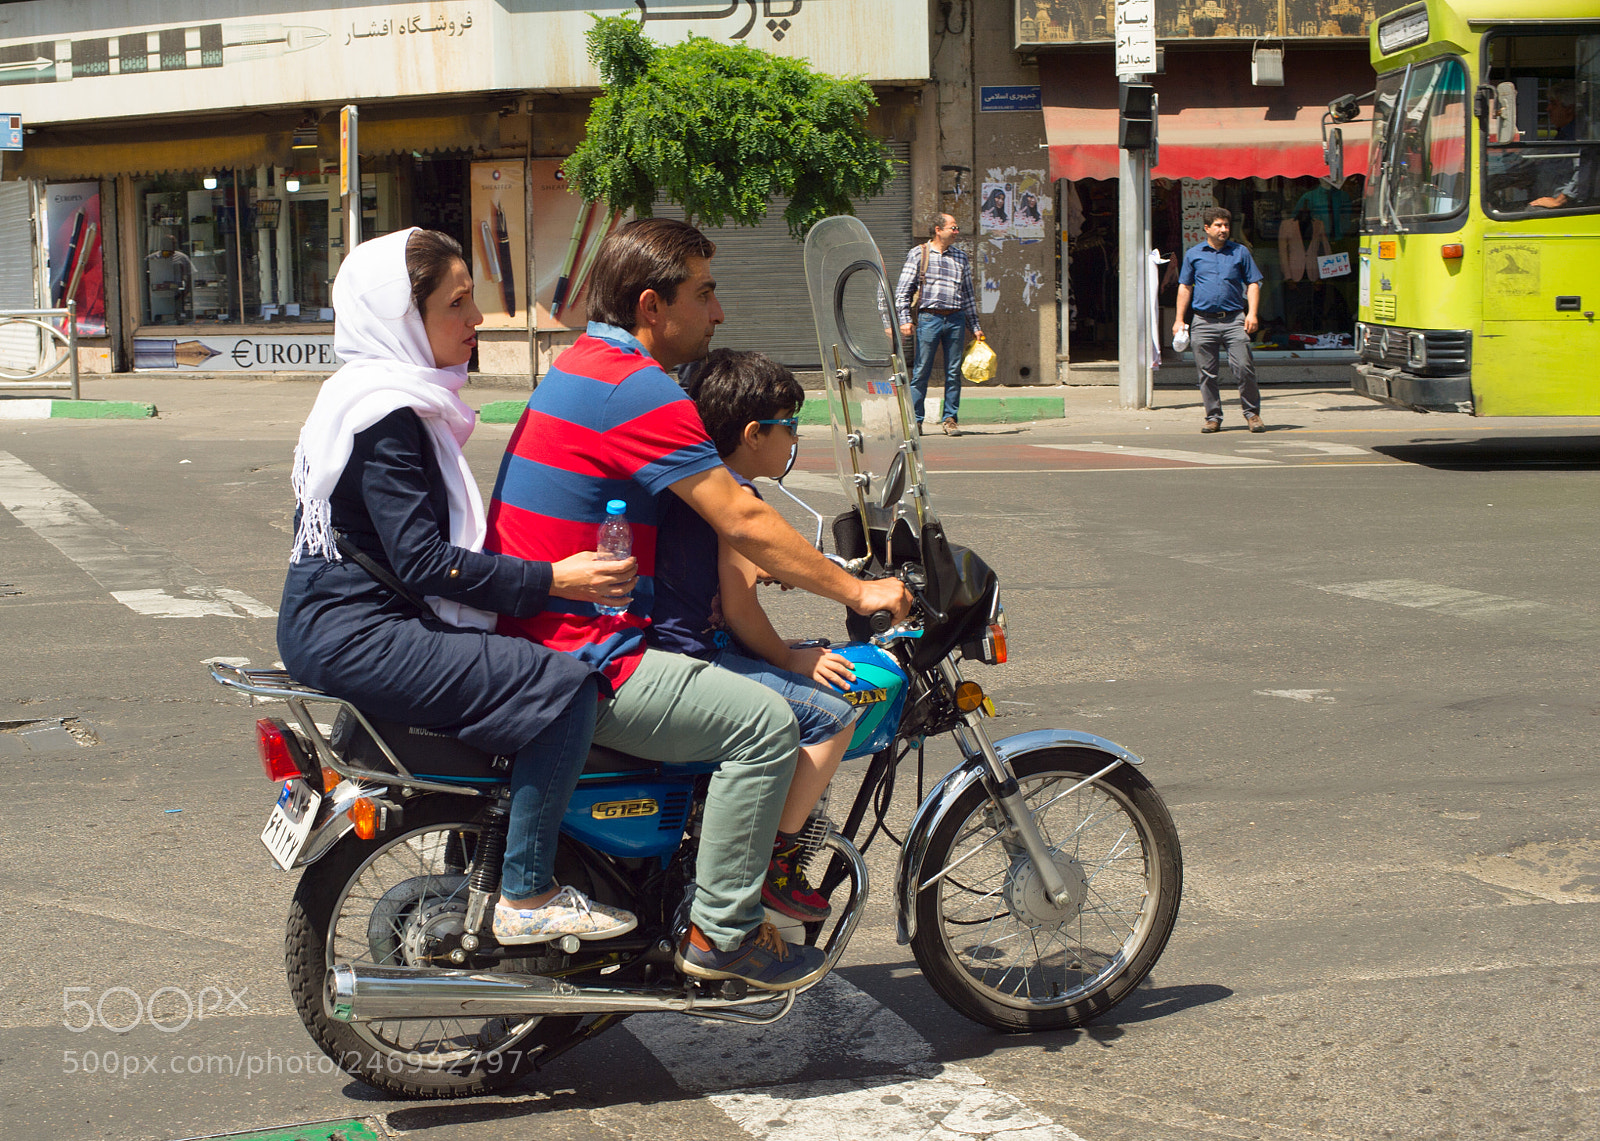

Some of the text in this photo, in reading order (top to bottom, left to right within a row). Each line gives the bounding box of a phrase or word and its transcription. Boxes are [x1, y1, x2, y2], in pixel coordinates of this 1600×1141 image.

[344, 11, 473, 46] فروشگاه افشار
[984, 92, 1037, 102] جمهوری اسلامی
[1184, 232, 1205, 242] ۹۹۰
[231, 339, 336, 368] €UROPE
[597, 801, 656, 817] CG125
